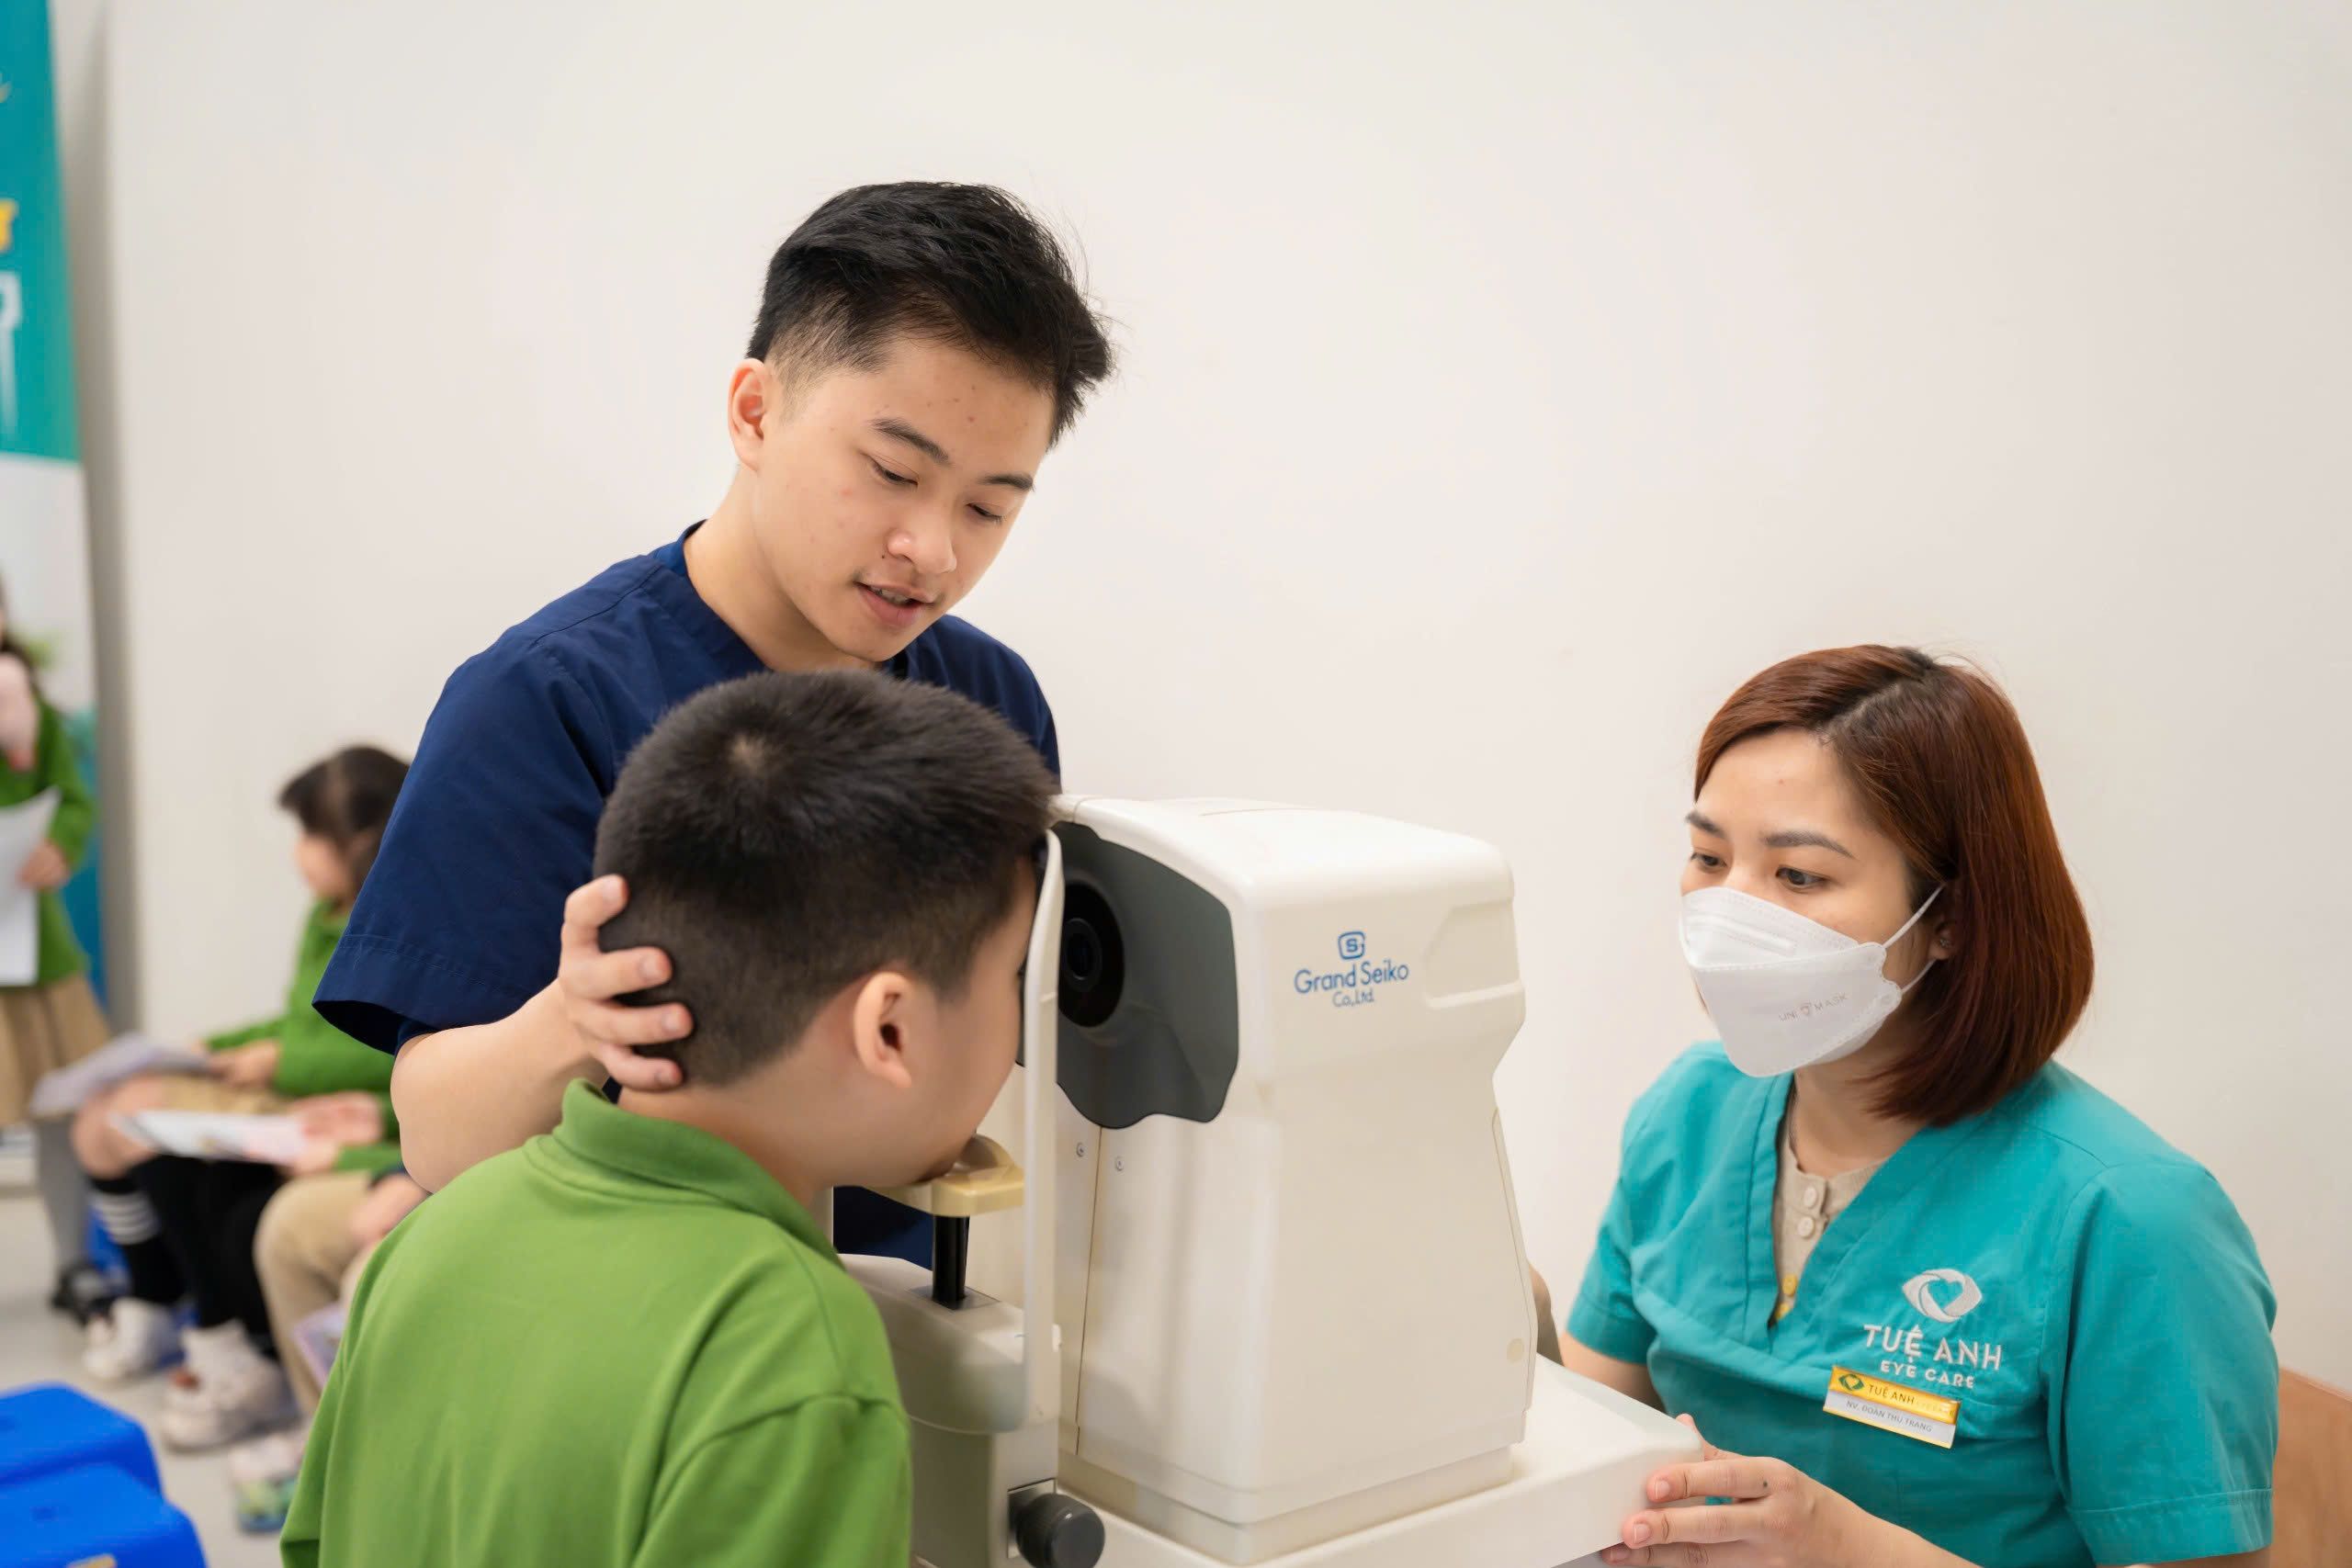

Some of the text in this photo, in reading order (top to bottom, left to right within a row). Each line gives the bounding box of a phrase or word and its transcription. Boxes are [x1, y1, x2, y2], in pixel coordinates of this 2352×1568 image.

[1294, 959, 1409, 993] Grand Seiko
[1863, 1324, 2002, 1371] TUỆ ANH
[1880, 1360, 1975, 1389] EYE CARE
[1890, 1391, 1916, 1404] ANH
[1905, 1417, 1933, 1433] TRANG
